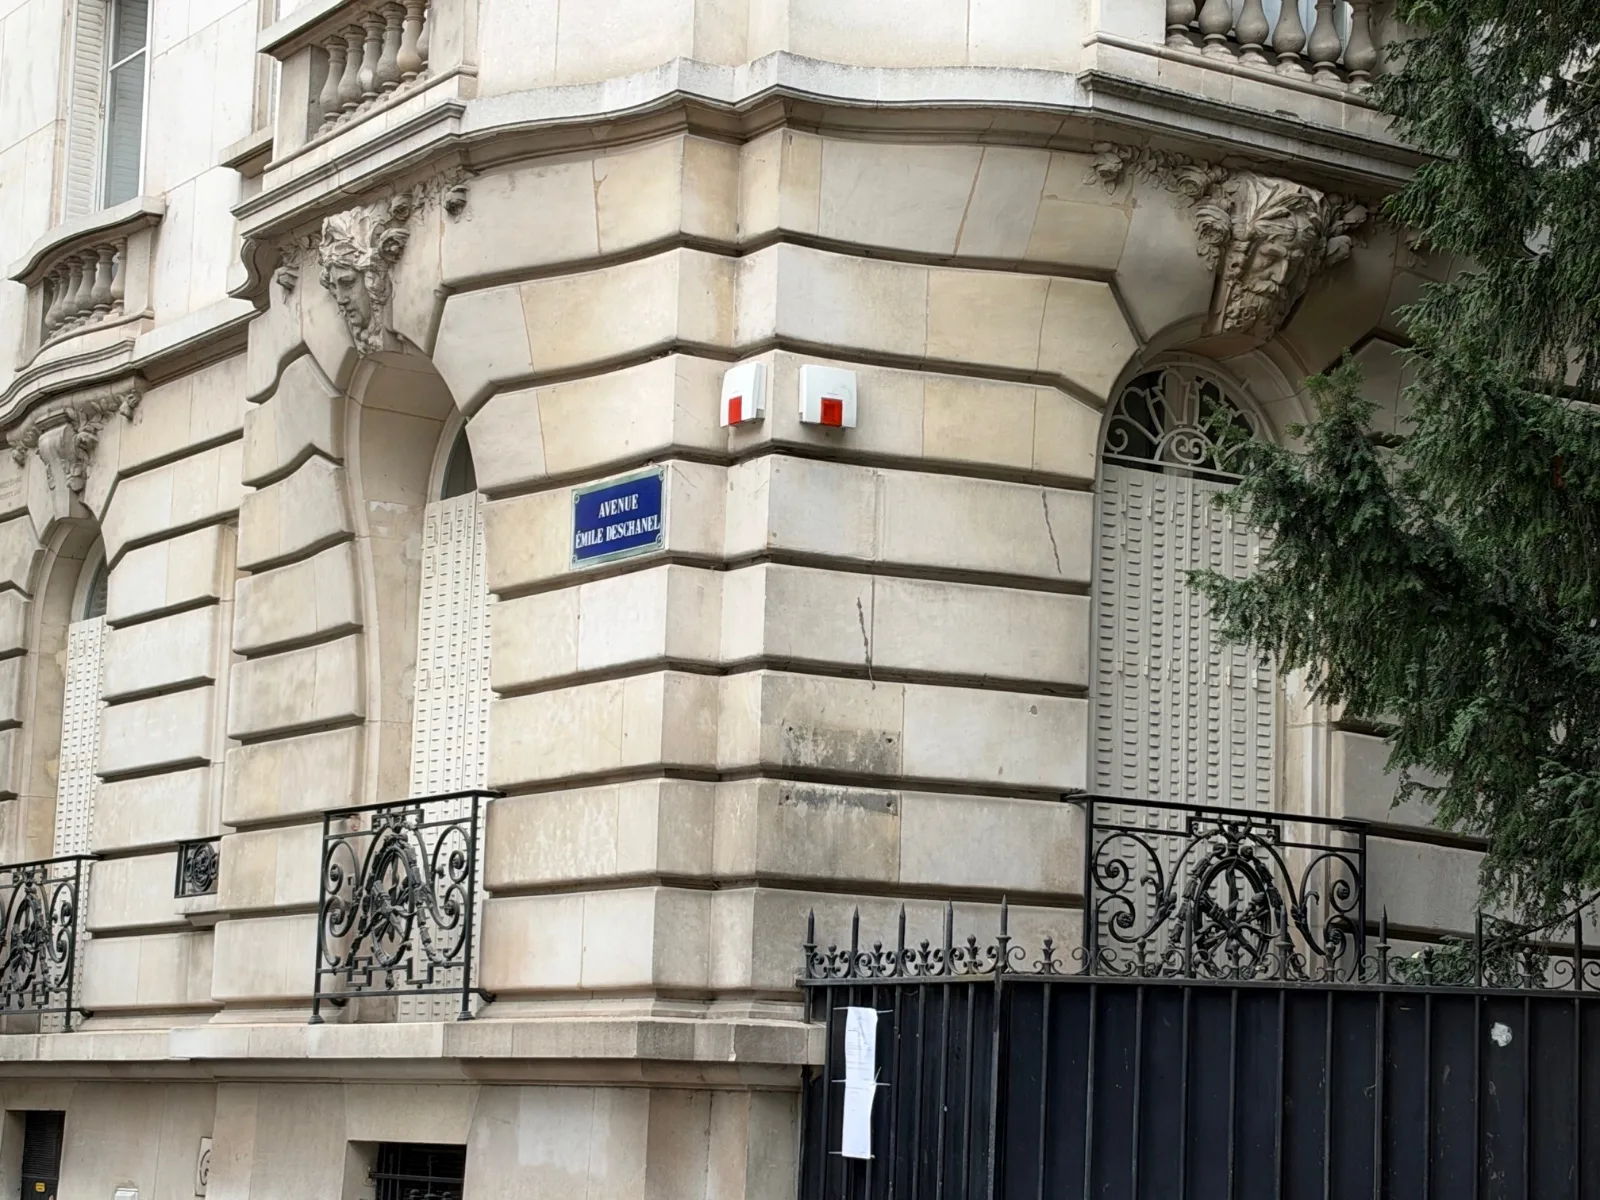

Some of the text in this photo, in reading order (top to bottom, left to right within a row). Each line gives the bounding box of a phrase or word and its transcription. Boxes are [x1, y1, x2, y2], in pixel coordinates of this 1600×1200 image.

[598, 494, 639, 518] AVENUE
[575, 514, 661, 549] ÉMILE DESCHANEL
